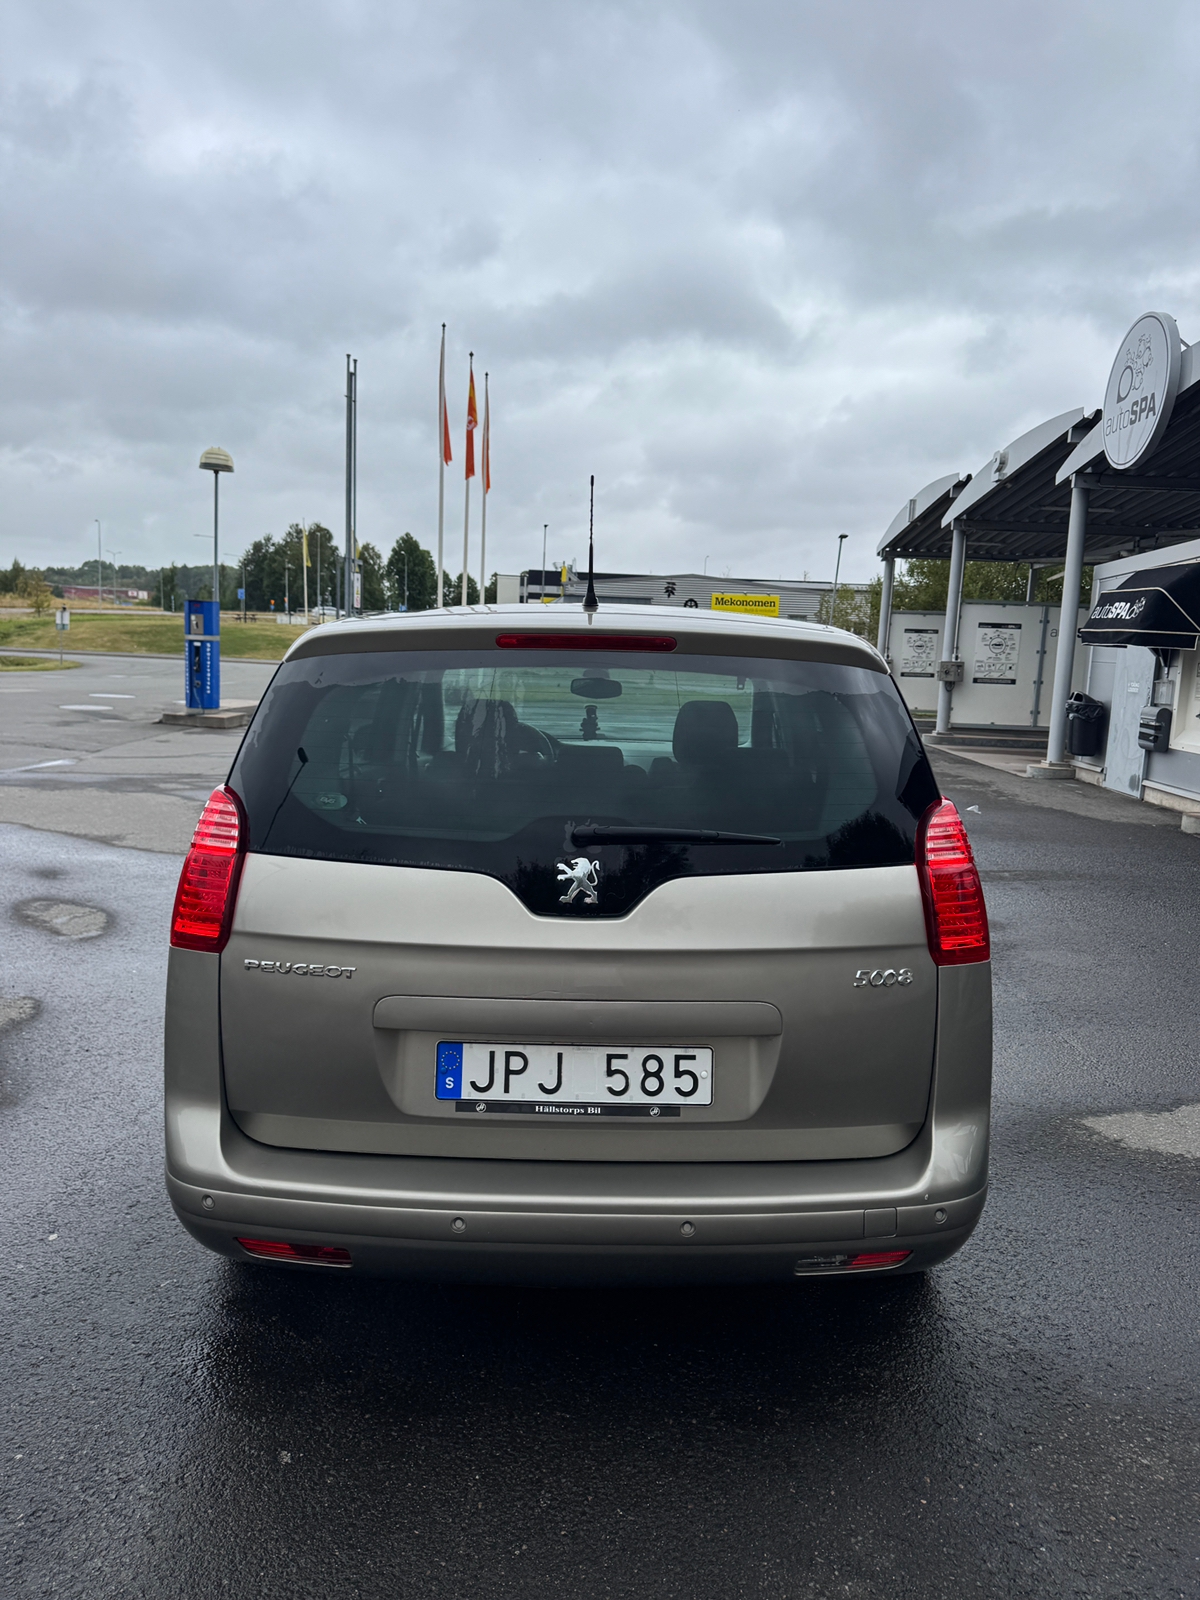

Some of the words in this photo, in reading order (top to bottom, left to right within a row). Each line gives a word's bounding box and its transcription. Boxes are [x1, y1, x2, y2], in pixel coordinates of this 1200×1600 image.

[1106, 392, 1156, 437] autoSPA
[715, 597, 776, 608] Mekonomen
[1091, 602, 1131, 619] autoSPA
[244, 959, 357, 979] PEUGEOT
[853, 968, 913, 987] 5008
[445, 1077, 454, 1089] S
[470, 1050, 563, 1095] JPJ
[606, 1053, 699, 1098] 585
[535, 1105, 585, 1115] Hällstorps
[587, 1106, 601, 1115] Bil
